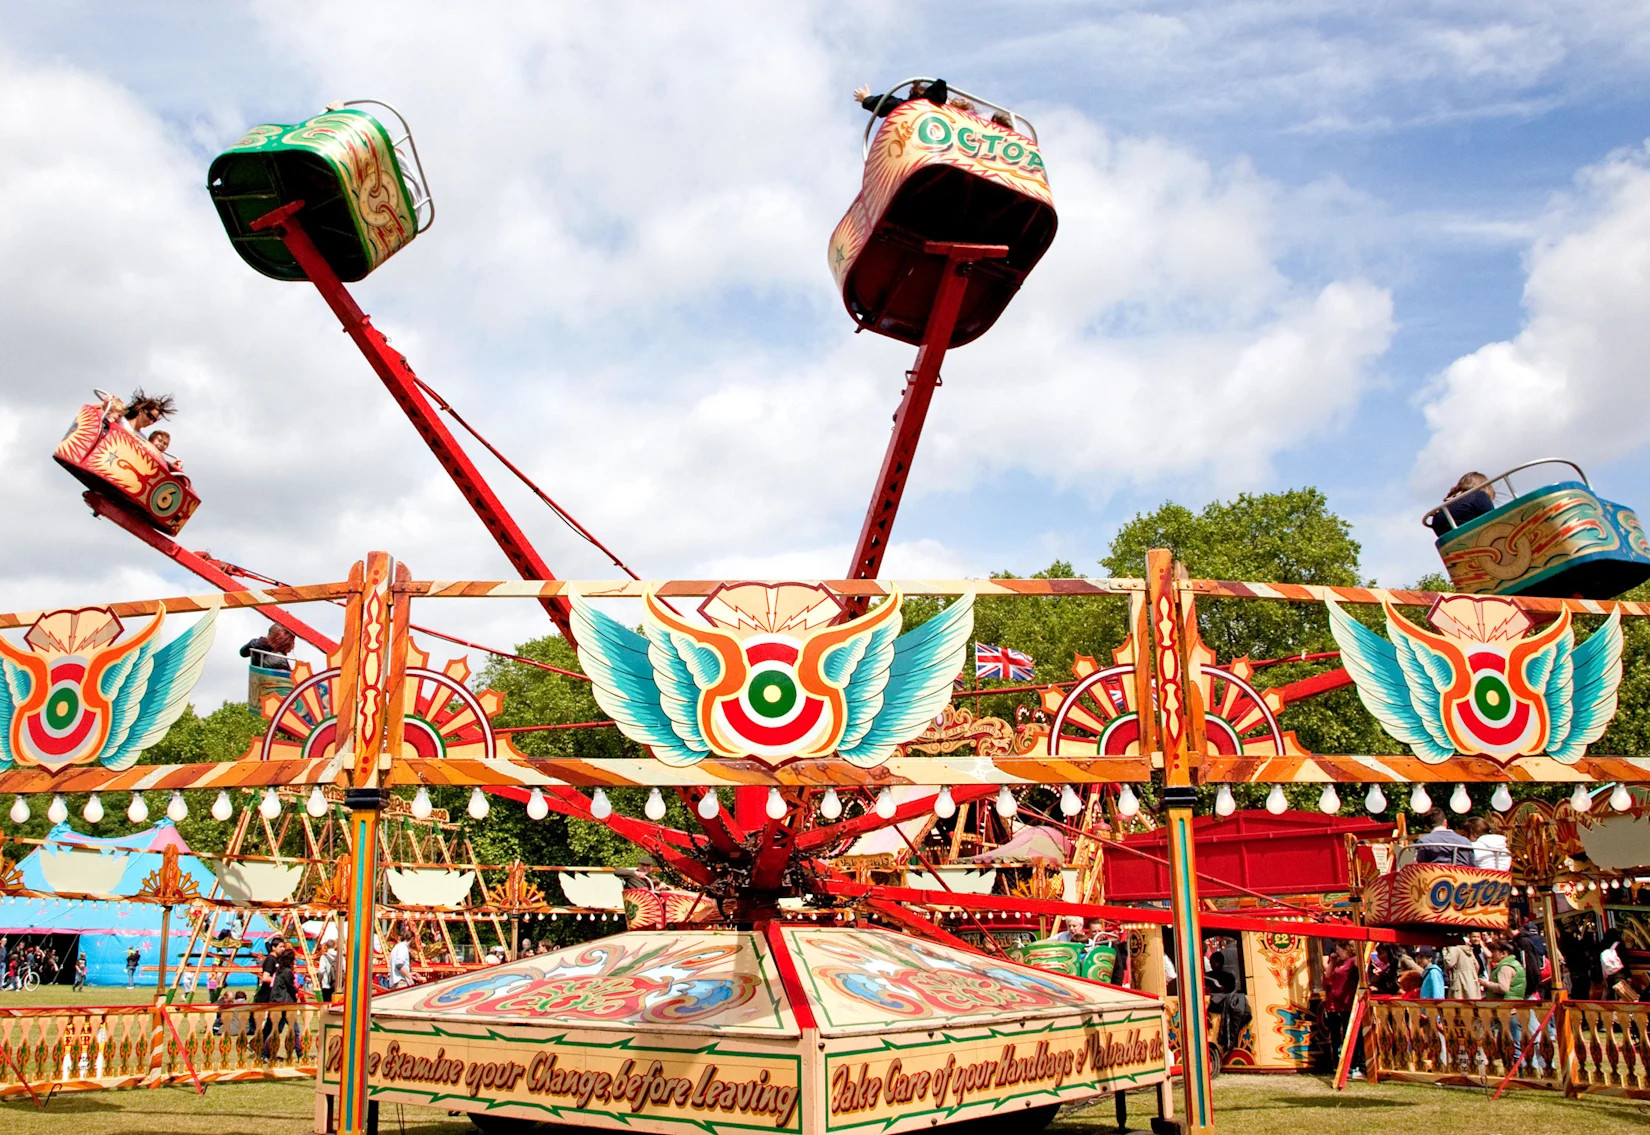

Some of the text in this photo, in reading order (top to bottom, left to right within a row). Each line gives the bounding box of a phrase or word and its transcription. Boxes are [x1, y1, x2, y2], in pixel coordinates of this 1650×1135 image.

[157, 487, 177, 510] 6
[1275, 933, 1290, 944] £2
[325, 1034, 380, 1075] Ple
[381, 1040, 464, 1085] Examine
[465, 1061, 526, 1098] your
[611, 1058, 691, 1113] before
[691, 1064, 799, 1128] Leaving
[831, 1062, 883, 1114] Take
[883, 1057, 931, 1103] Care
[931, 1053, 955, 1108] of
[952, 1060, 998, 1105] your
[995, 1040, 1074, 1087] Handbags
[1087, 1029, 1147, 1071] Valuables
